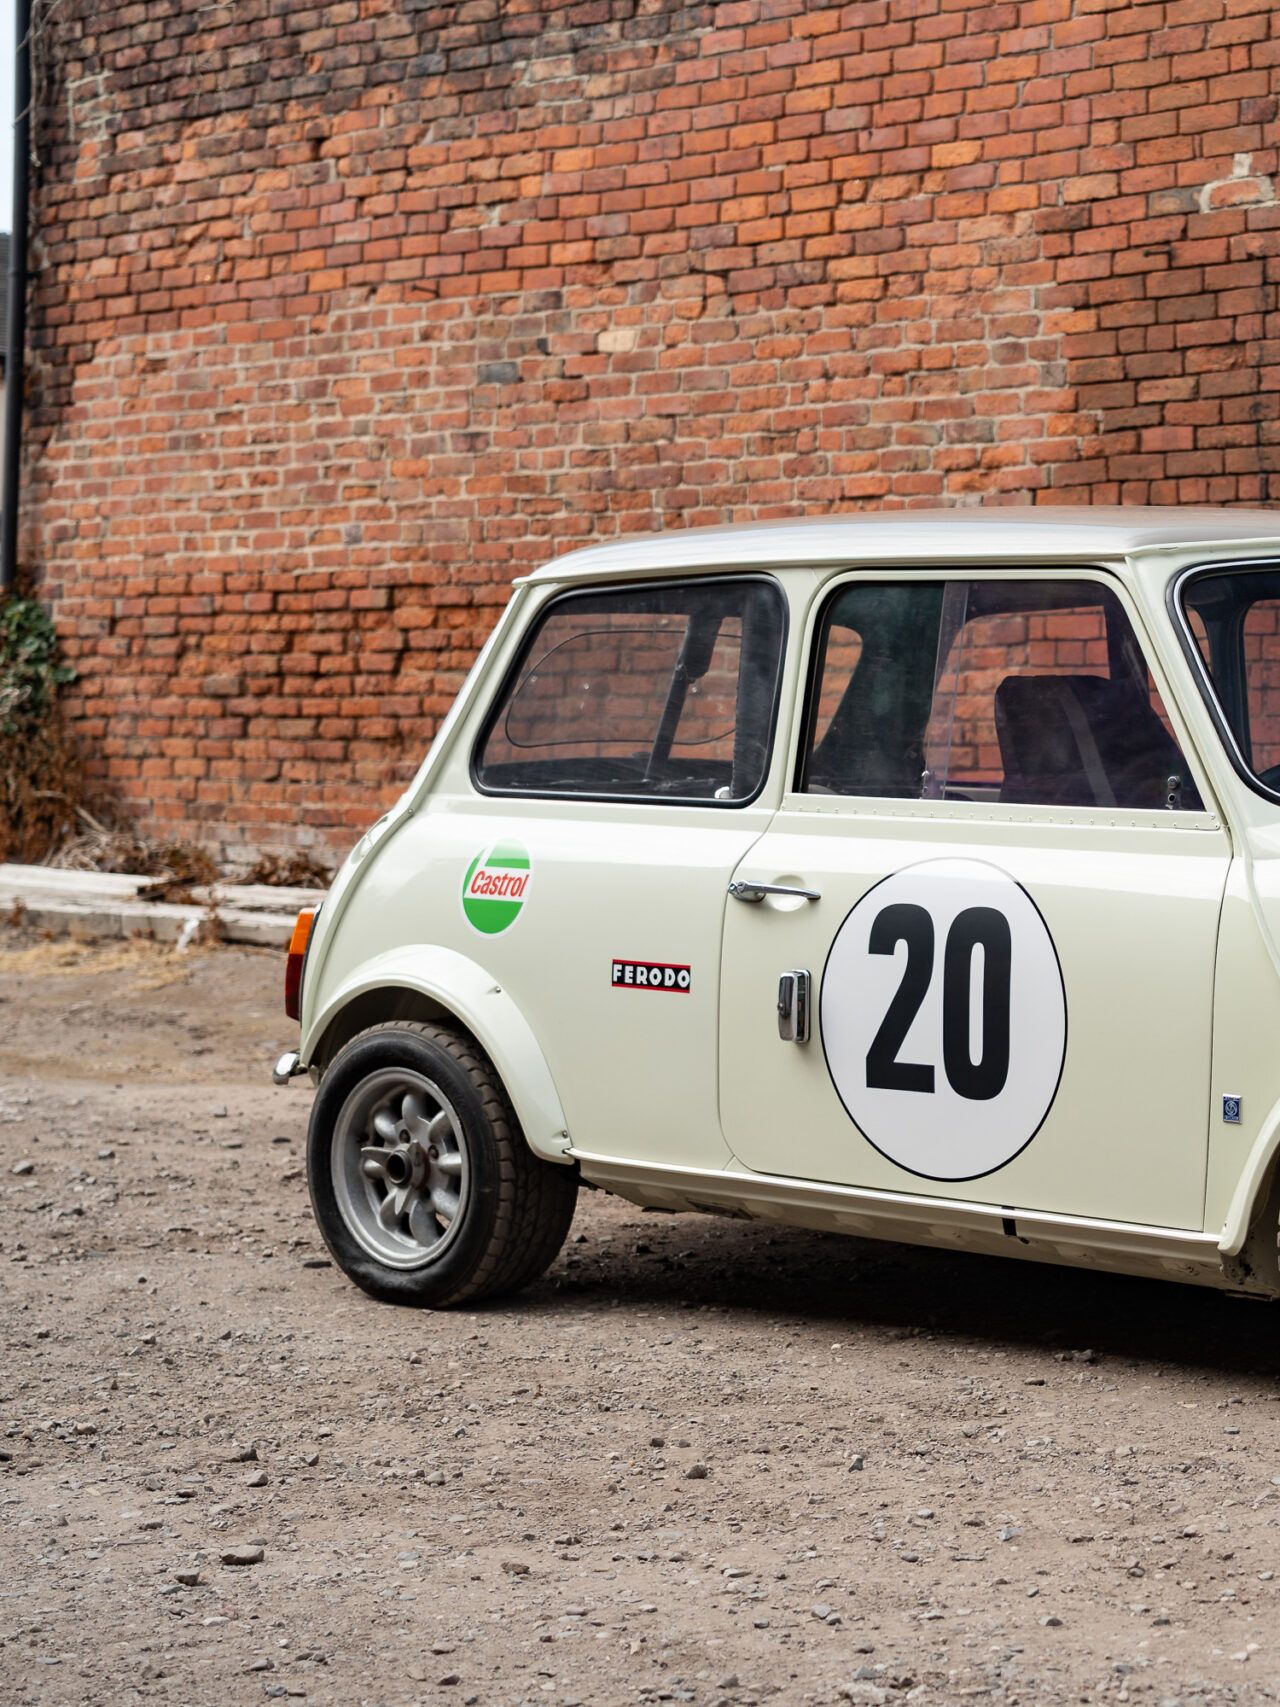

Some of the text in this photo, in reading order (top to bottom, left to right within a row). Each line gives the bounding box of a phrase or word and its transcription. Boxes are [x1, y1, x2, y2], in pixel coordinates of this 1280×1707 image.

[470, 870, 530, 898] Castrol
[612, 963, 691, 989] FERODO
[866, 903, 1012, 1101] 20
